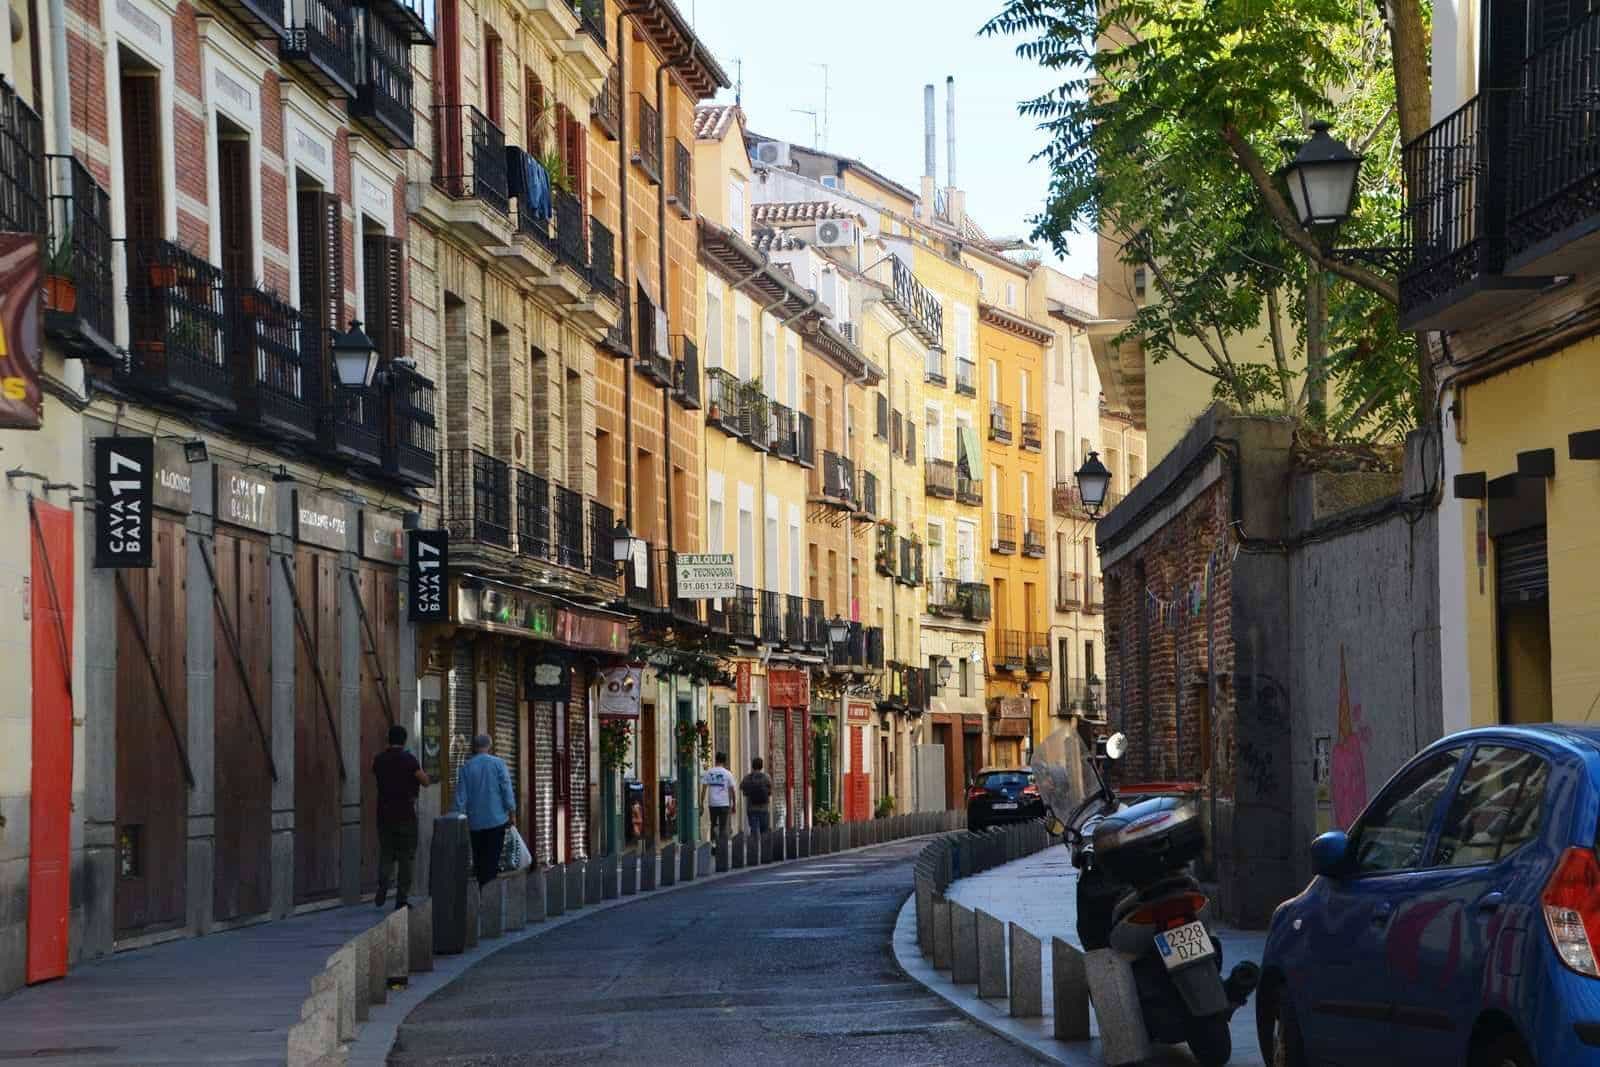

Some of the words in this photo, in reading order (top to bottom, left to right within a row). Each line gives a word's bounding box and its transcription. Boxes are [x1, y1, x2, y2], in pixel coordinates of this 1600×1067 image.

[109, 451, 142, 496] 17
[231, 475, 250, 497] CAVA
[109, 500, 124, 553] CAVA
[126, 500, 141, 553] BAJA
[417, 541, 440, 573] 17
[678, 554, 692, 564] SE
[693, 553, 733, 564] ALQUILA
[418, 575, 429, 612] CAVA
[430, 574, 441, 612] BAJA
[1167, 923, 1204, 948] 2328
[1175, 939, 1206, 960] DZX
